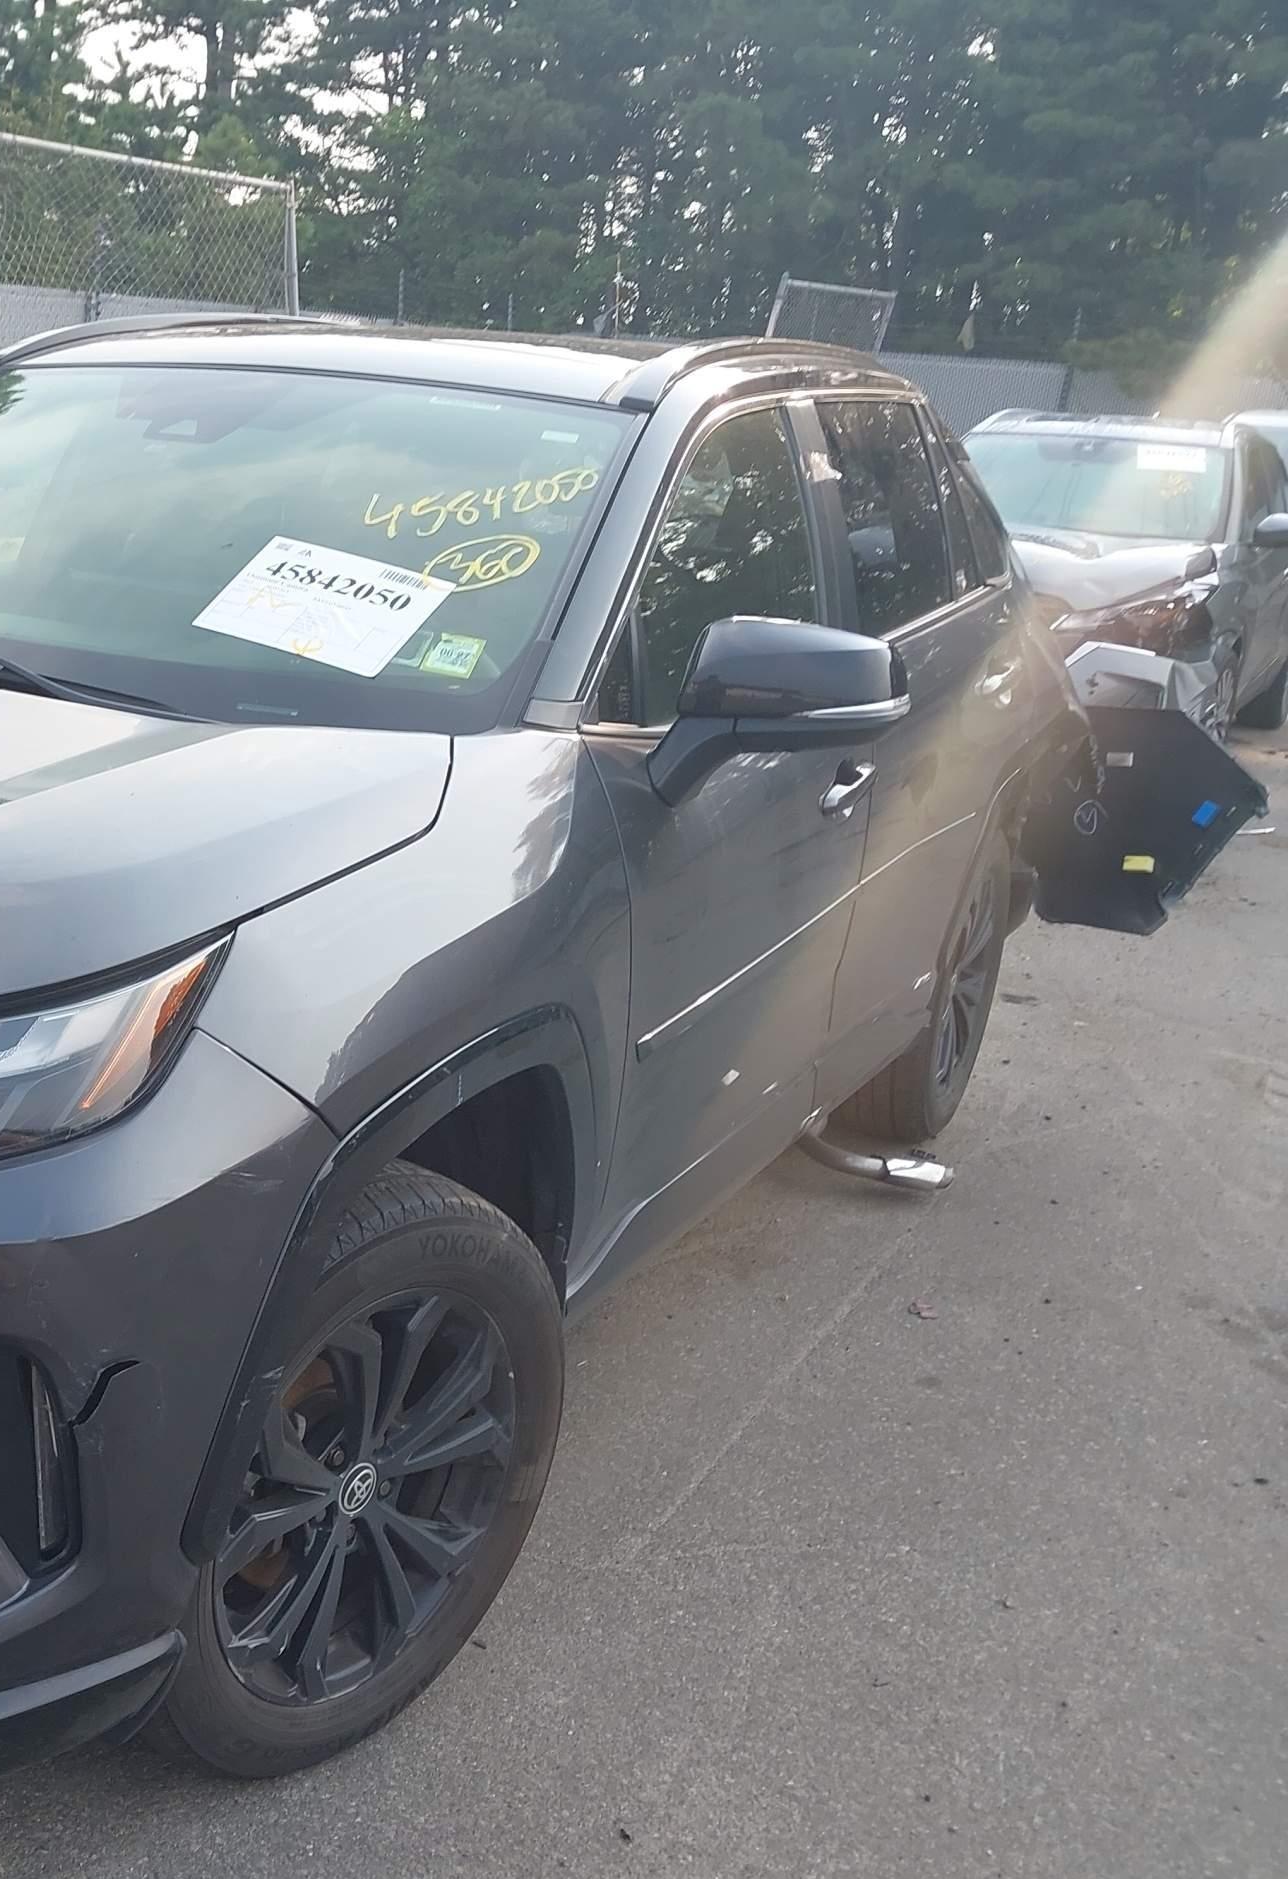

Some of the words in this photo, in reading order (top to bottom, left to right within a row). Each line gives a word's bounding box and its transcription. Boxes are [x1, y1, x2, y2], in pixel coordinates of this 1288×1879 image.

[364, 467, 600, 539] 45842050
[266, 560, 412, 611] 45842050
[419, 1233, 525, 1276] YOKOHAM
